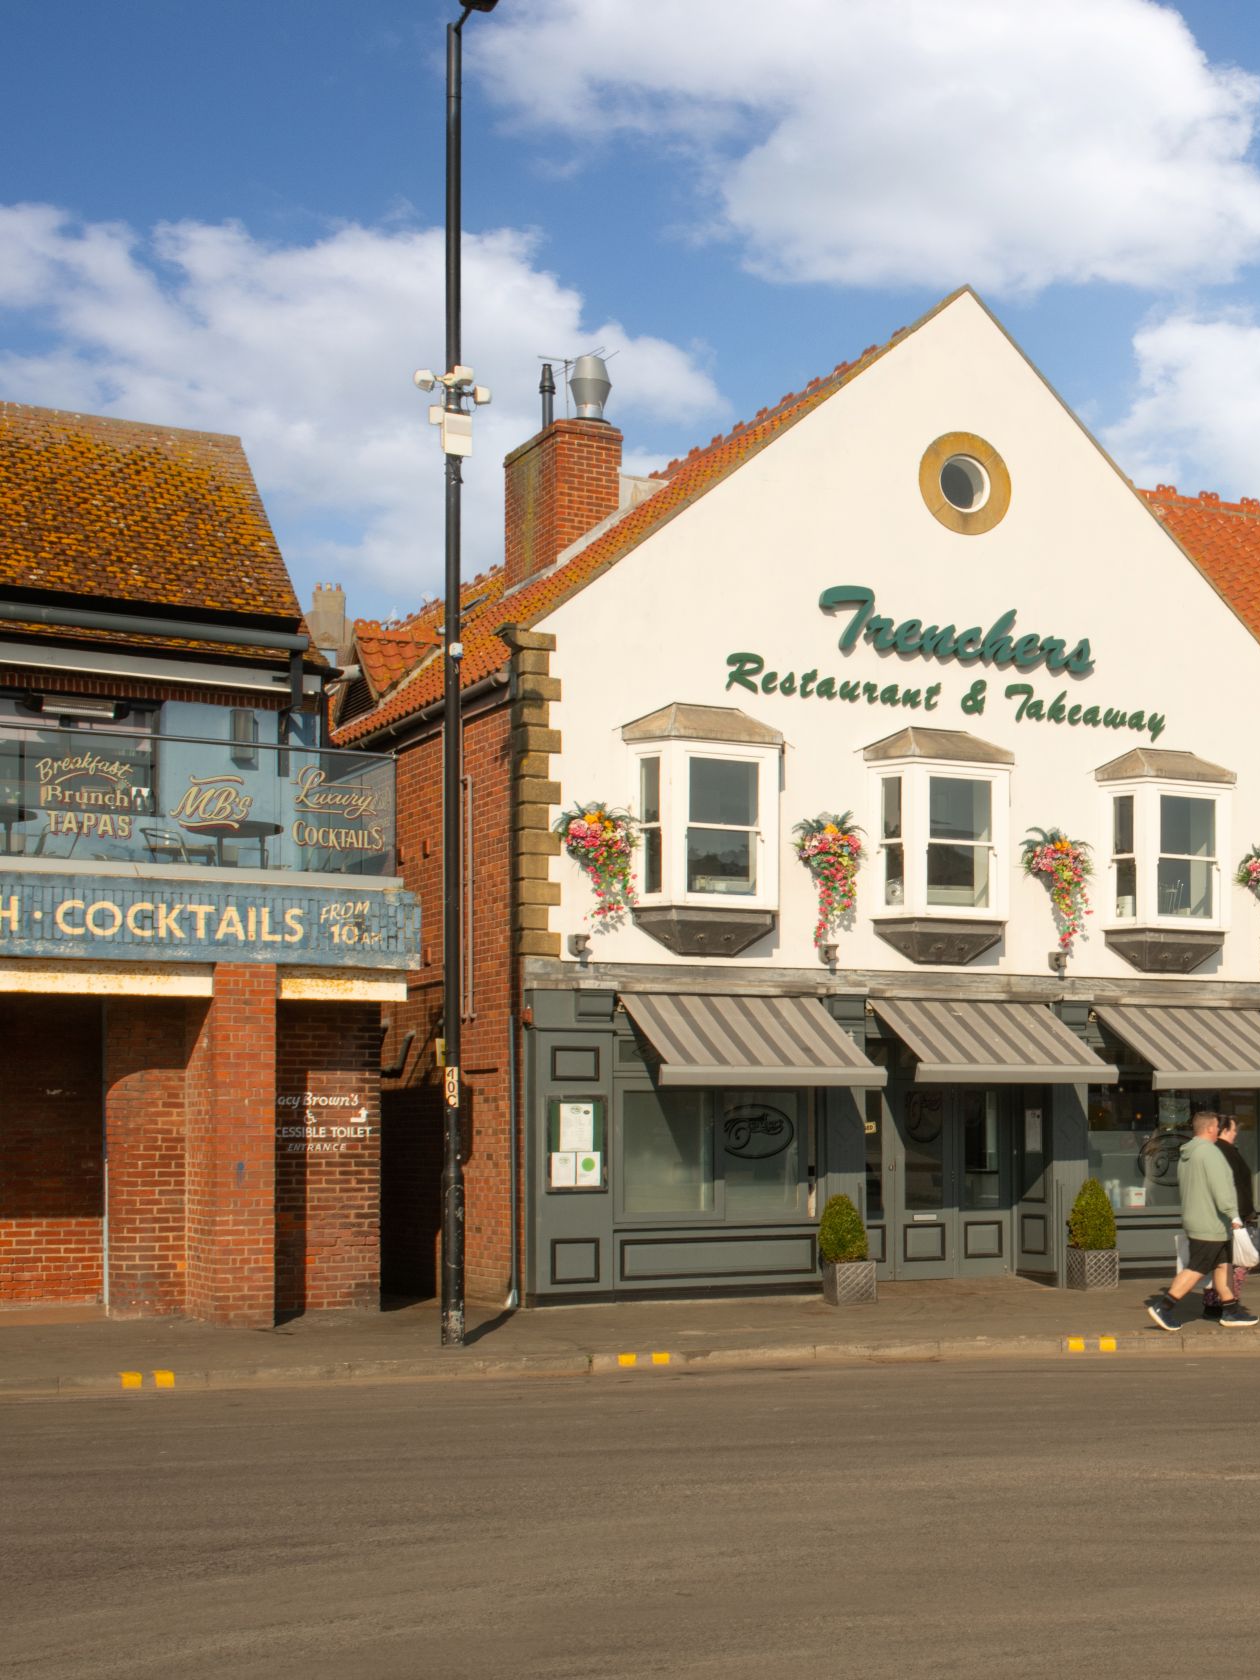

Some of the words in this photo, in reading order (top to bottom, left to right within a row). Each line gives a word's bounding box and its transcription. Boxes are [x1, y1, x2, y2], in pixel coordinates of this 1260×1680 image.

[818, 585, 1096, 674] Trenchers
[725, 652, 942, 711] Restaurant
[960, 679, 987, 714] &
[1004, 683, 1166, 742] Takeaway
[35, 752, 133, 784] Breakfast
[46, 785, 129, 807] Brunch
[296, 765, 376, 819] Luxury
[47, 810, 132, 838] TAPAS
[291, 820, 384, 851] COCKTAILS
[55, 899, 304, 943] COCKTAILS
[320, 900, 370, 924] FROM
[303, 1091, 359, 1106] Brown's
[330, 1126, 373, 1138] TOILET
[287, 1143, 347, 1151] ENTRANCE
